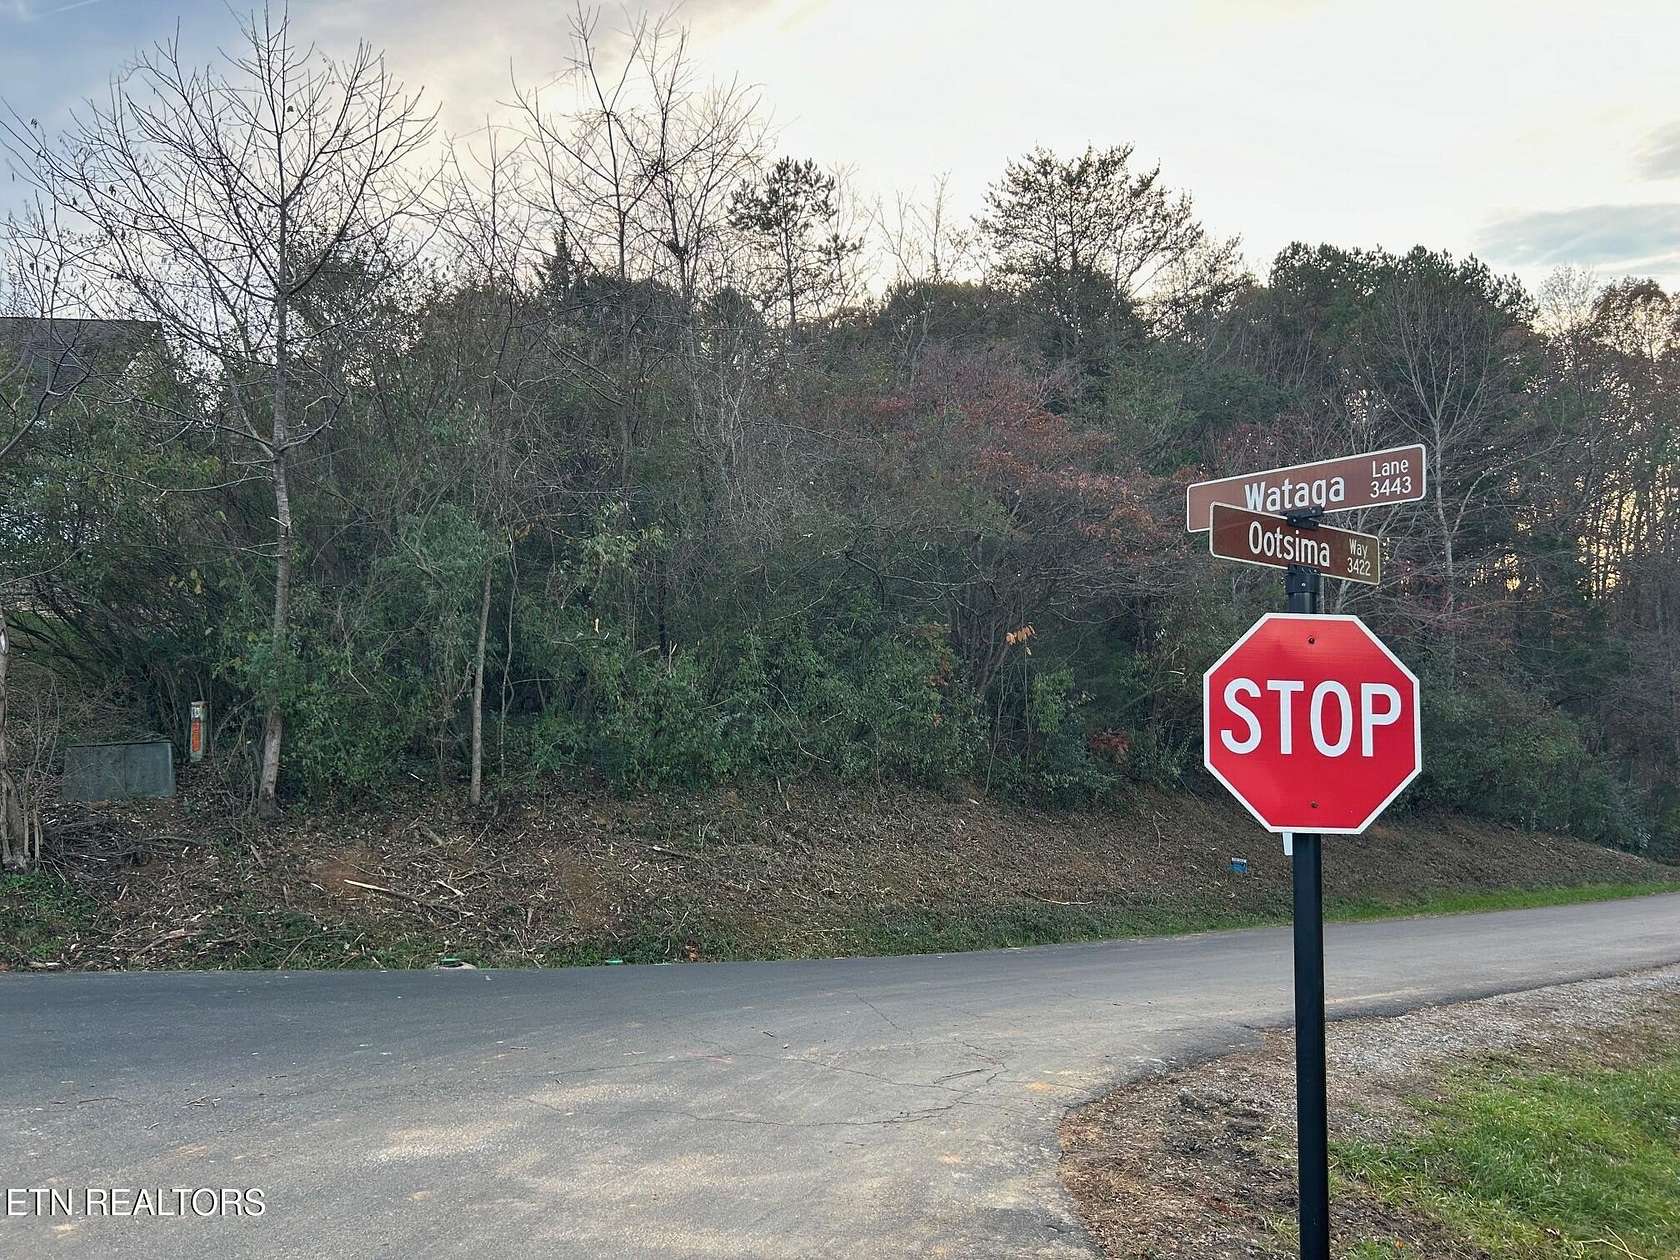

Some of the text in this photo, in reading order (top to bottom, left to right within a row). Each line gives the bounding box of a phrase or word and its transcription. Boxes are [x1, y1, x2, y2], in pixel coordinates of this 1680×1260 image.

[1372, 459, 1409, 478] Lane
[1369, 476, 1412, 498] 3443
[1248, 520, 1330, 568] Ootsima
[1348, 538, 1368, 558] Way
[1347, 558, 1371, 577] 3422
[1220, 677, 1402, 758] STOP
